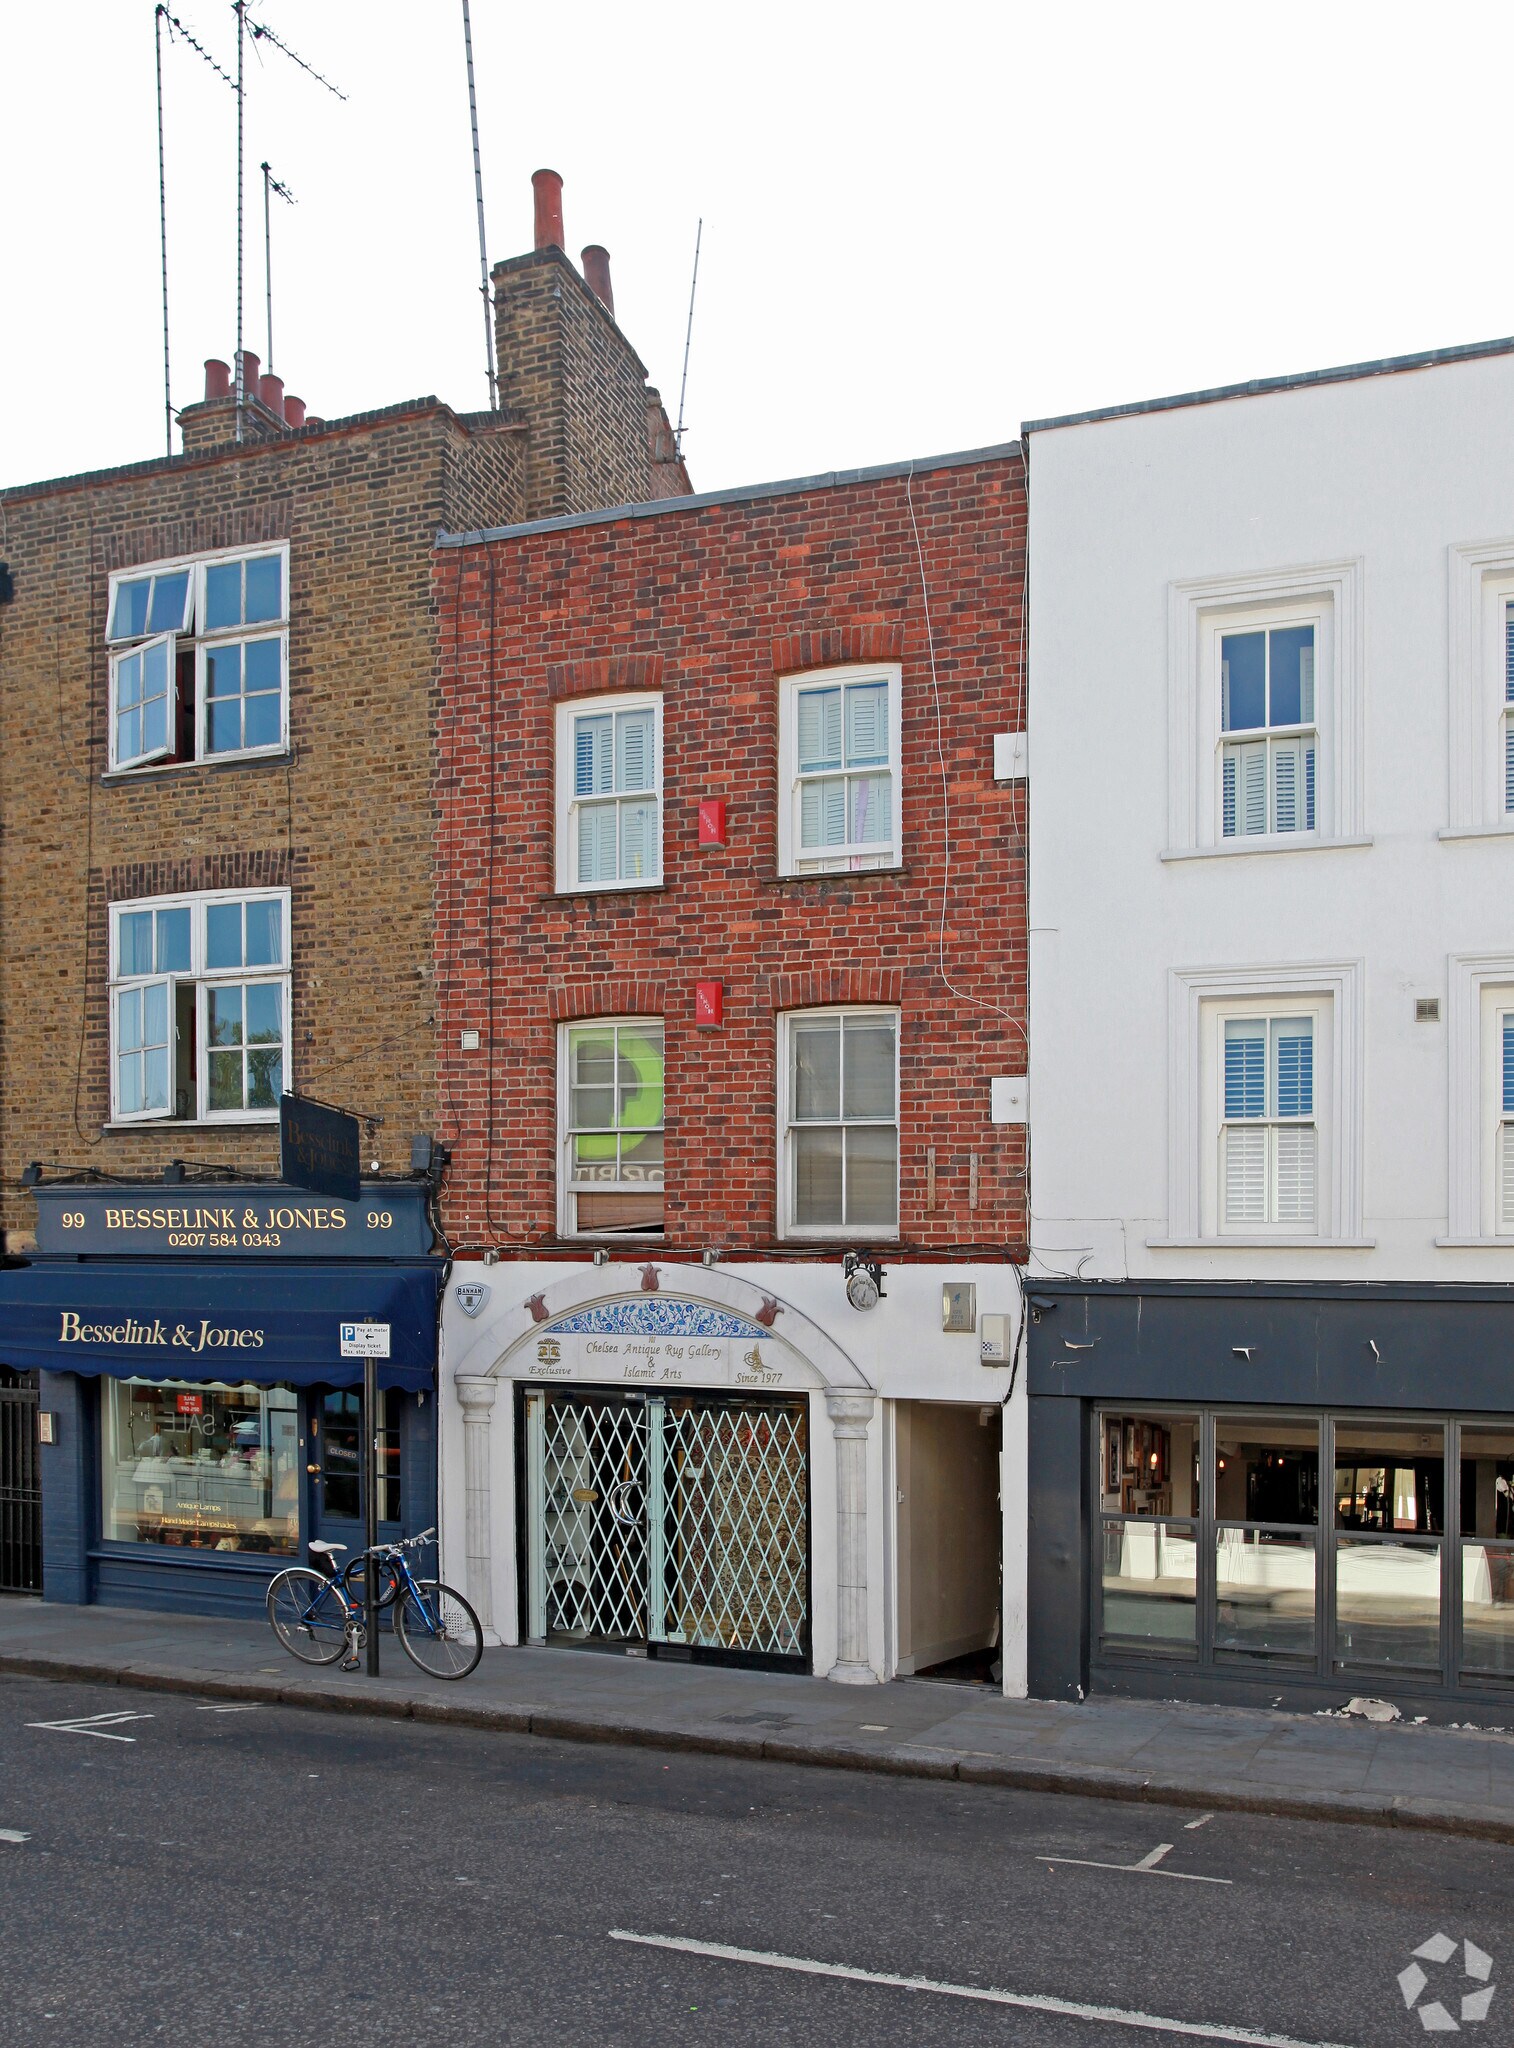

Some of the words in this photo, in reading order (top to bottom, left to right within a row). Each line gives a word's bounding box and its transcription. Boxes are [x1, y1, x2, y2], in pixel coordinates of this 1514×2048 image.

[62, 1212, 86, 1229] 99
[105, 1208, 237, 1229] BESSELINK
[242, 1208, 260, 1229] &
[265, 1208, 347, 1229] JONES
[366, 1211, 393, 1229] 99
[168, 1232, 206, 1247] 0207
[209, 1233, 238, 1247] 584
[242, 1233, 281, 1247] 0343
[58, 1311, 168, 1346] Besselink
[172, 1324, 195, 1347] &
[191, 1319, 264, 1352] Jones
[586, 1341, 619, 1354] Chelsea
[623, 1343, 660, 1358] Antique
[664, 1344, 684, 1359] Rug
[688, 1344, 722, 1360] Gallery
[647, 1355, 656, 1368] &
[528, 1366, 572, 1376] Exclusive
[660, 1368, 682, 1380] Arts
[735, 1373, 758, 1384] Since
[761, 1373, 783, 1384] 1977
[330, 1447, 357, 1459] CLOSED
[175, 1502, 199, 1510] Antique
[200, 1503, 221, 1512] Lamps
[197, 1520, 237, 1529] Lampshades
